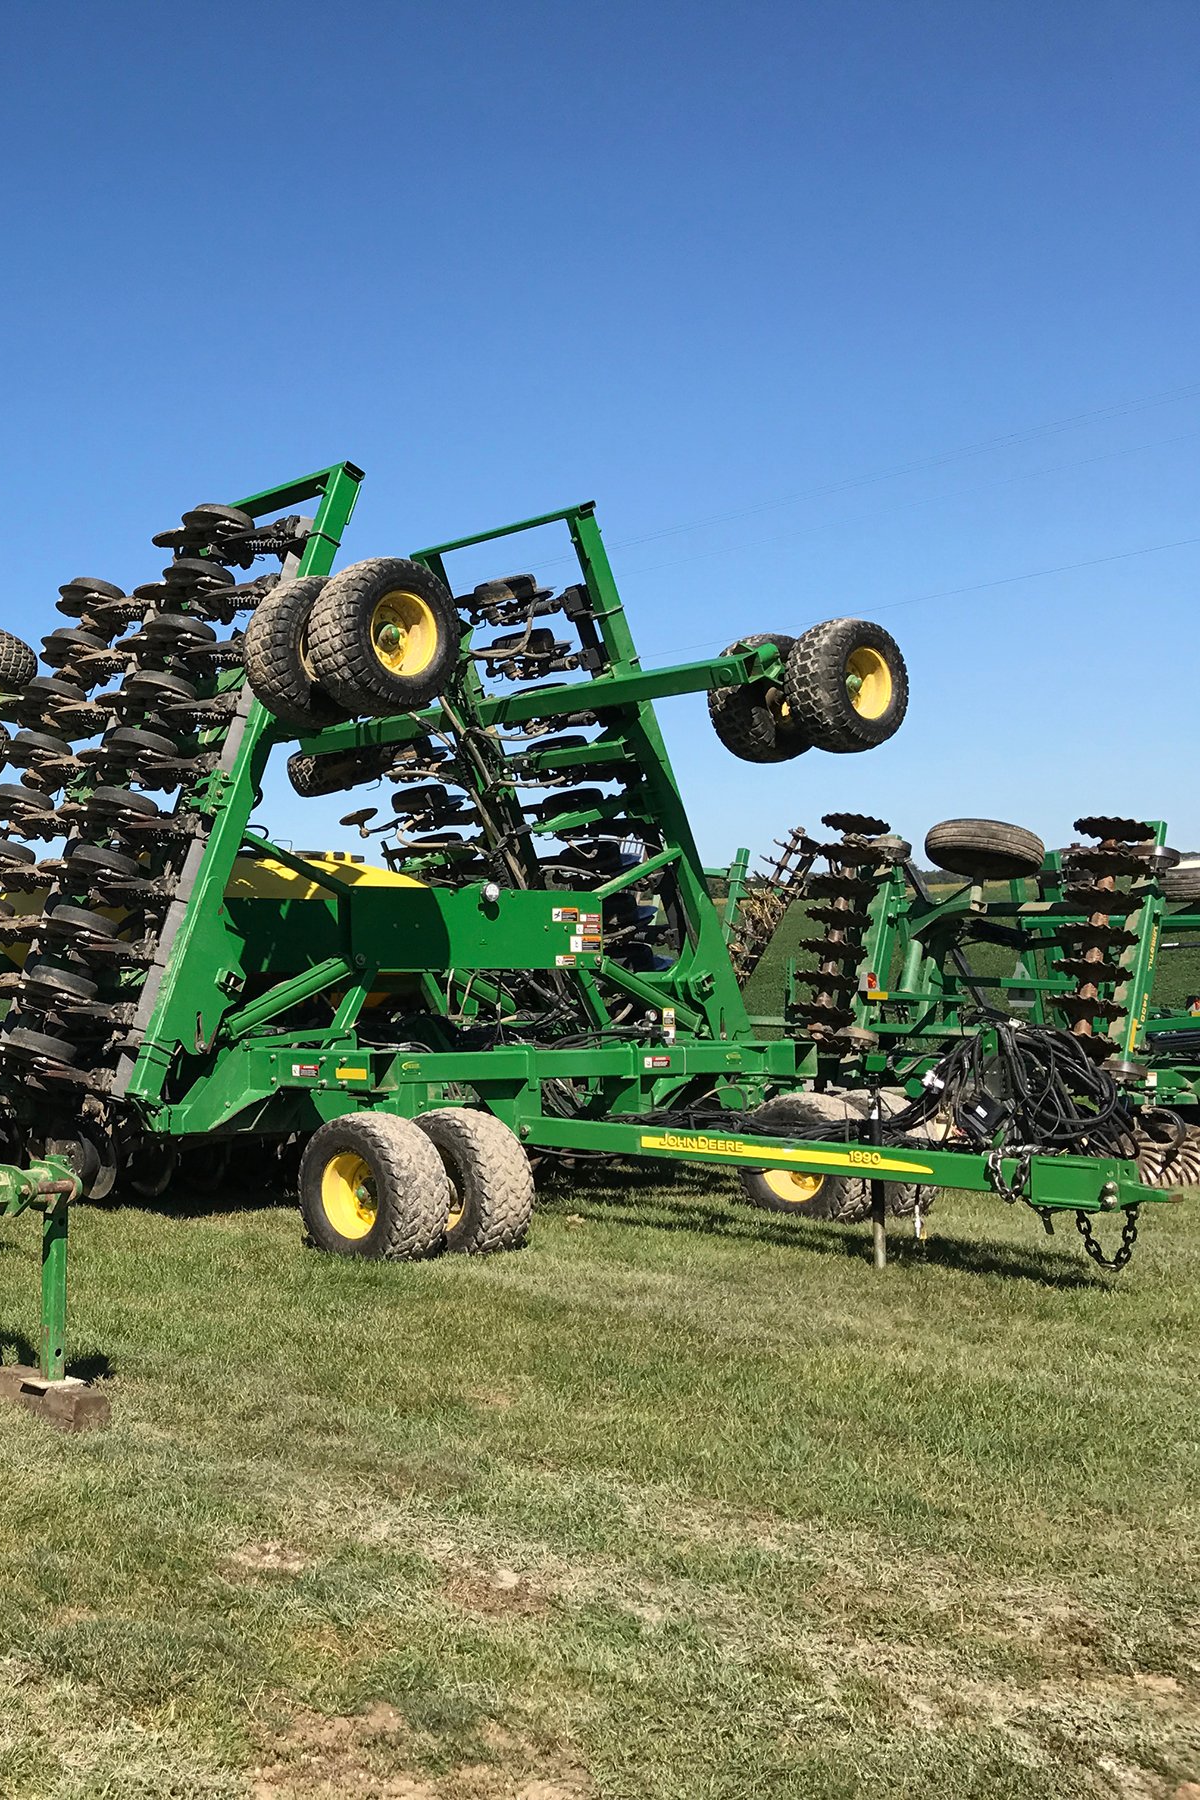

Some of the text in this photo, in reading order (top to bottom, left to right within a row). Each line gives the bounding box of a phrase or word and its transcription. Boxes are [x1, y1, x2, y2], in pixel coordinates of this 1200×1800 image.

[659, 1132, 744, 1152] JOHN DEERE
[849, 1150, 881, 1165] 1990
